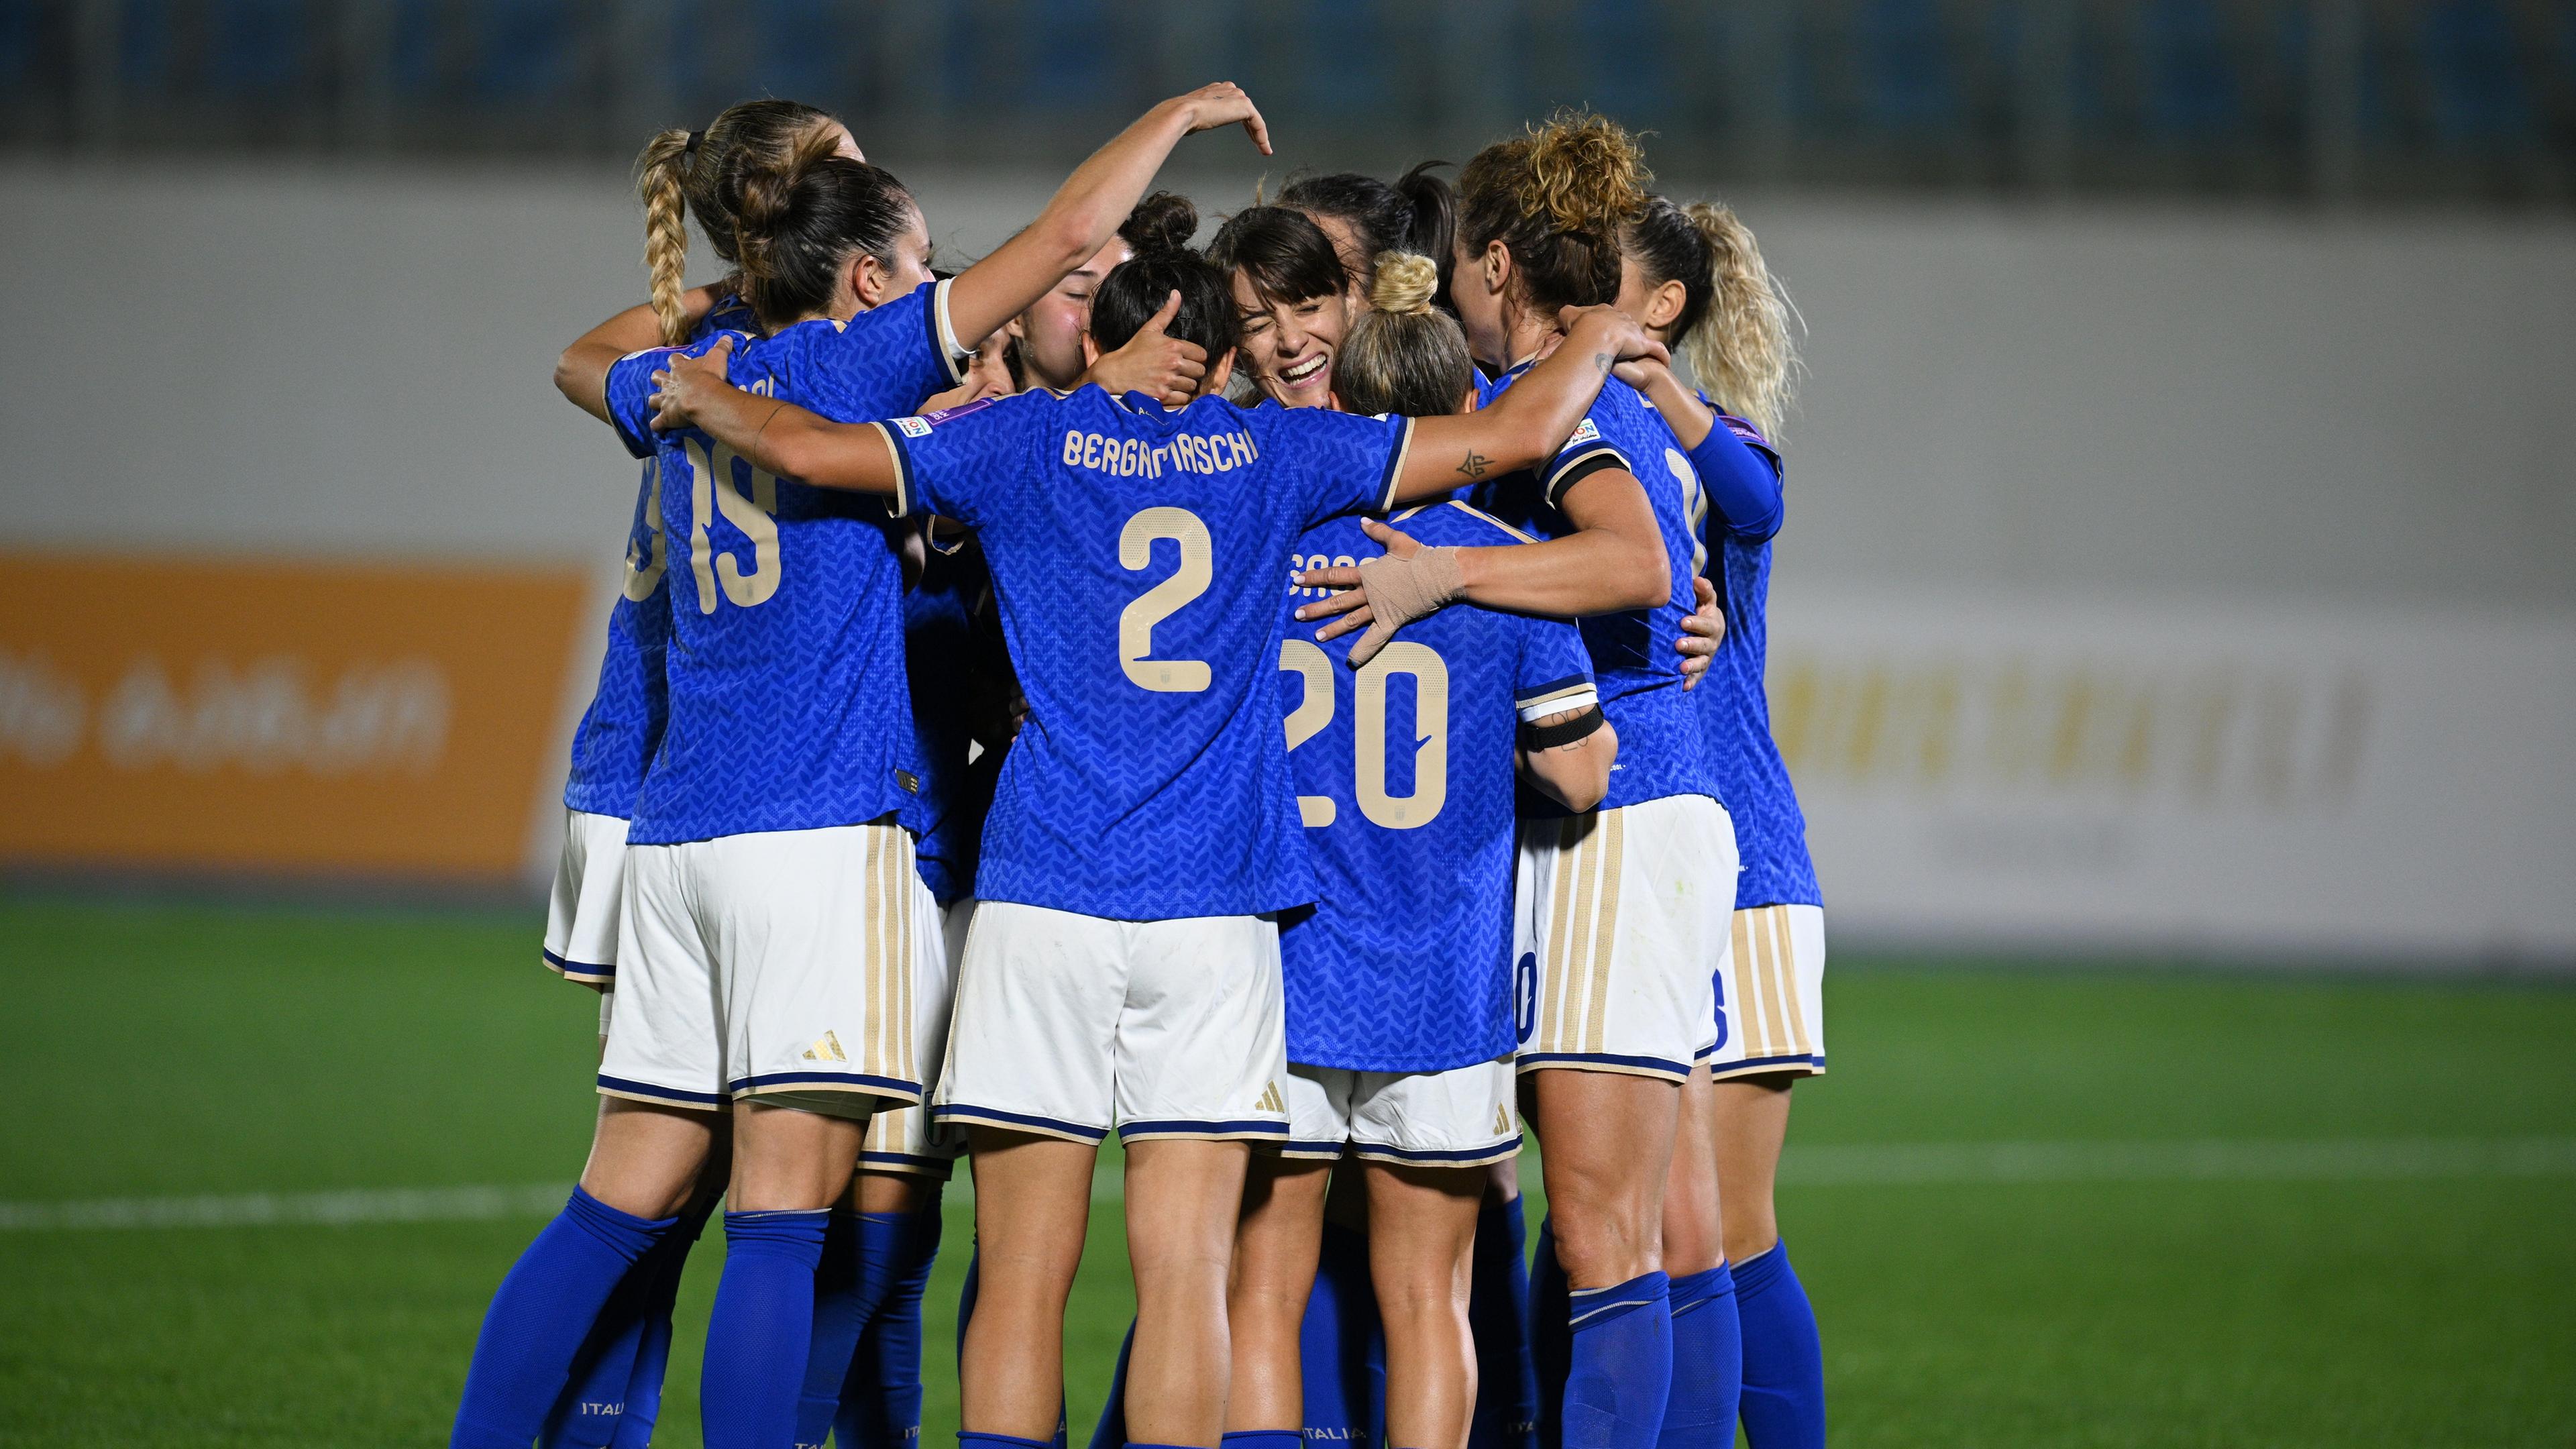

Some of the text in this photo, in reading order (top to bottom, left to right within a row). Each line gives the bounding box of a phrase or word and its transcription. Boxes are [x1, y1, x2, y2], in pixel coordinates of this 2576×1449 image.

[1063, 428, 1258, 480] BERGAMASCHI
[1119, 506, 1213, 692] 2
[1279, 639, 1449, 830] 20
